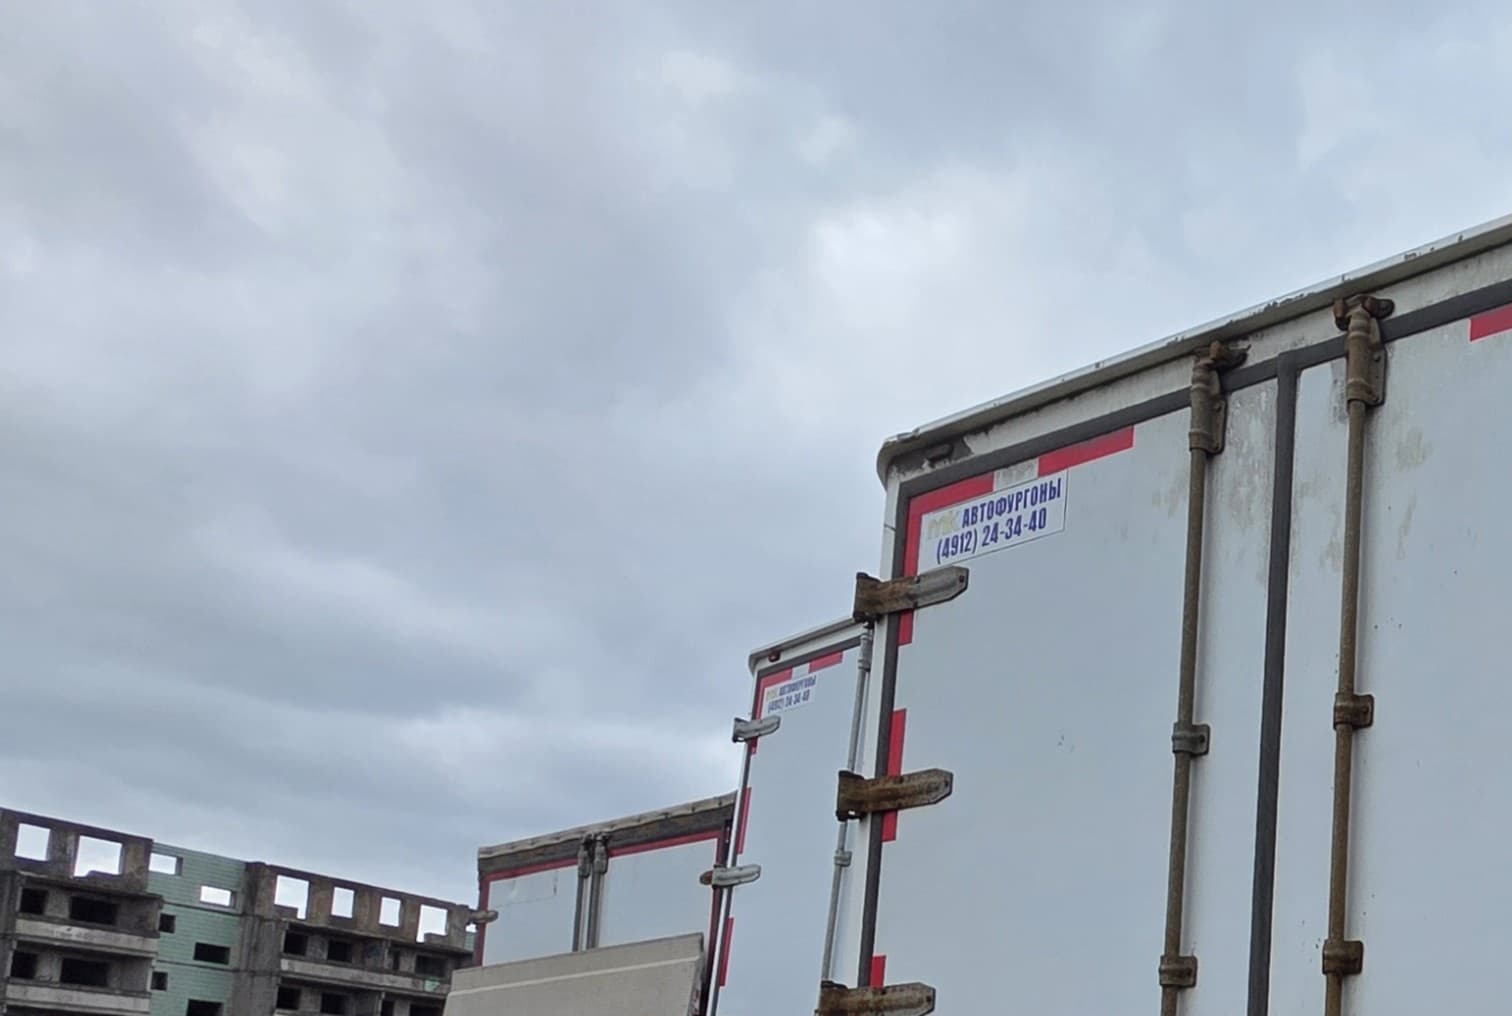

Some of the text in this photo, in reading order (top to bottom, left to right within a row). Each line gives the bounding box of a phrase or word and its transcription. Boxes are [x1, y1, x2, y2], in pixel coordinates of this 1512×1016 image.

[962, 478, 1061, 528] АВТОФУРГОНЫ
[936, 530, 978, 564] (4912)
[982, 508, 1047, 547] 24-34-40
